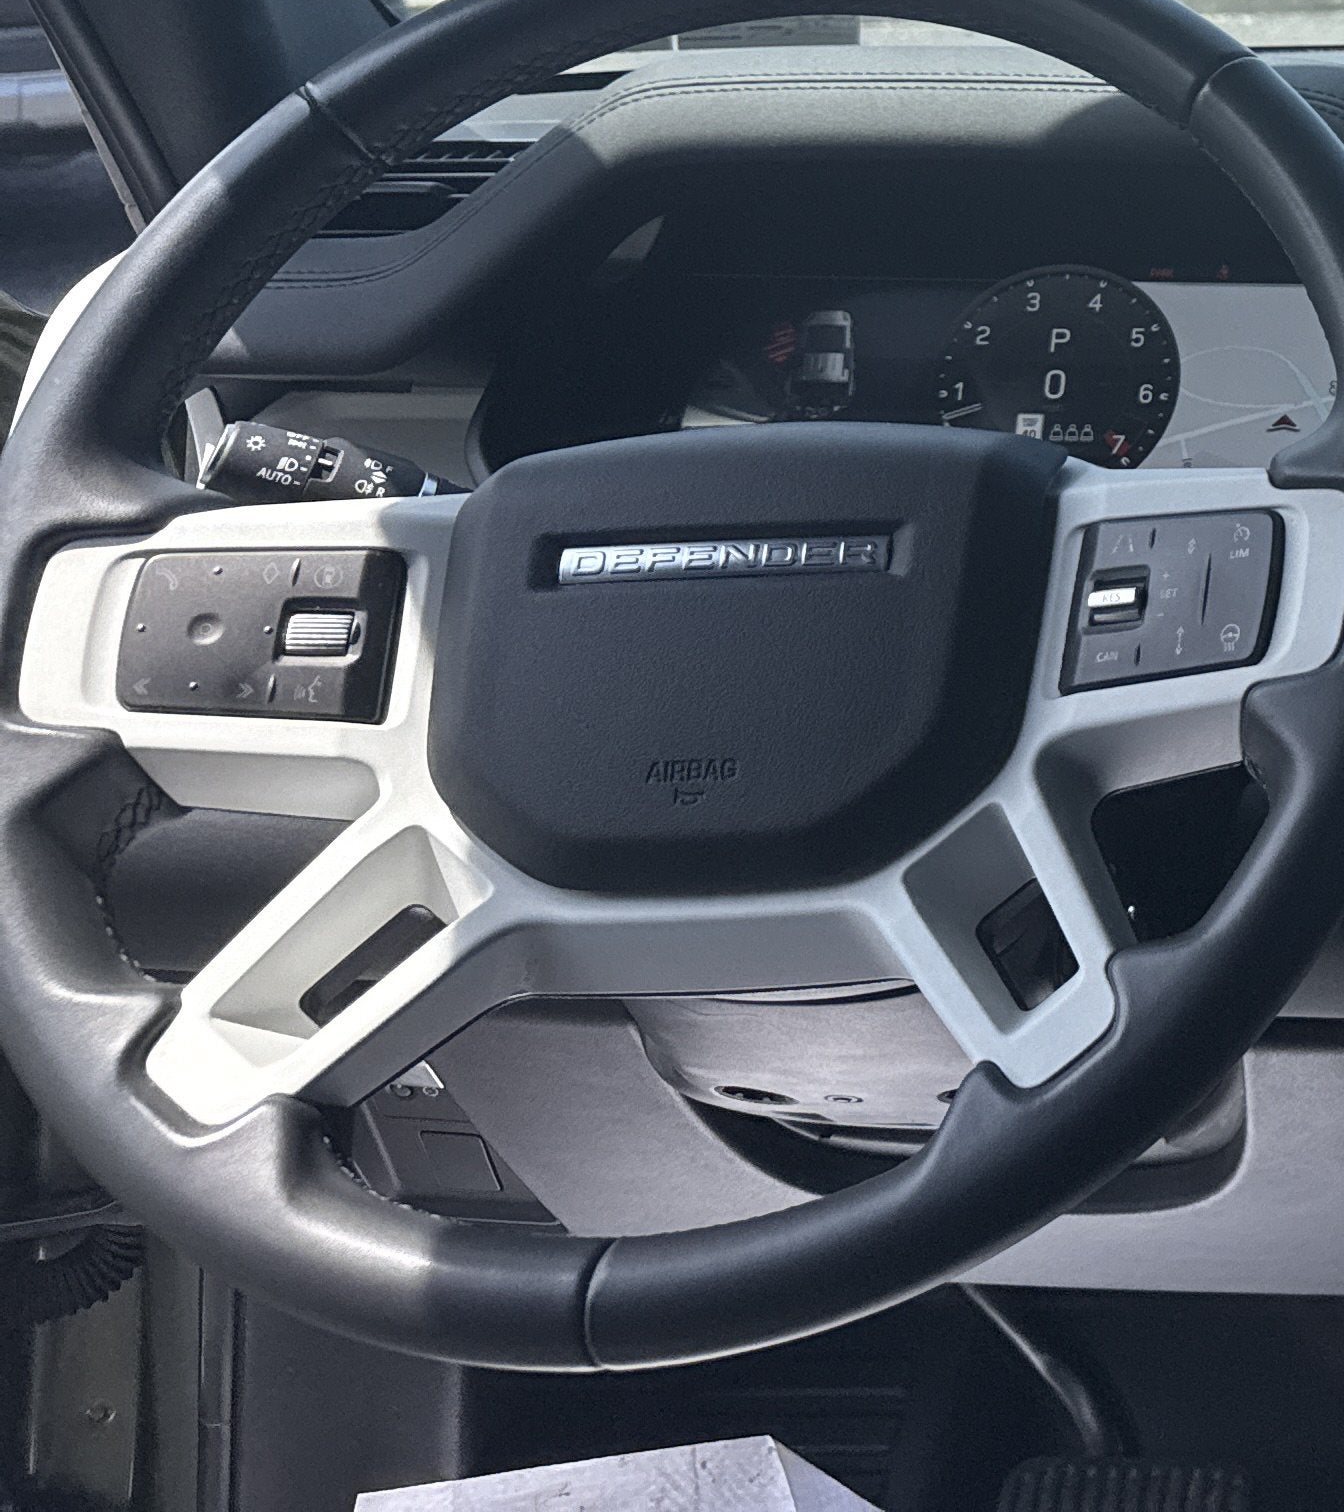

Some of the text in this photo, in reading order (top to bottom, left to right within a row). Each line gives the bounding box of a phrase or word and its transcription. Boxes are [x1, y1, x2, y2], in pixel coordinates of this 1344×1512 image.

[1026, 292, 1041, 312] 3
[1087, 293, 1102, 312] 4
[975, 325, 991, 345] 2
[1050, 328, 1071, 353] P
[1130, 328, 1146, 347] 5
[954, 382, 965, 401] 1
[1044, 369, 1066, 399] 0
[1138, 384, 1153, 403] 6
[1111, 435, 1126, 455] 7
[255, 467, 292, 486] AUTO
[375, 486, 386, 498] R
[571, 540, 879, 578] DEFENDER
[645, 757, 739, 784] AIRBAG
